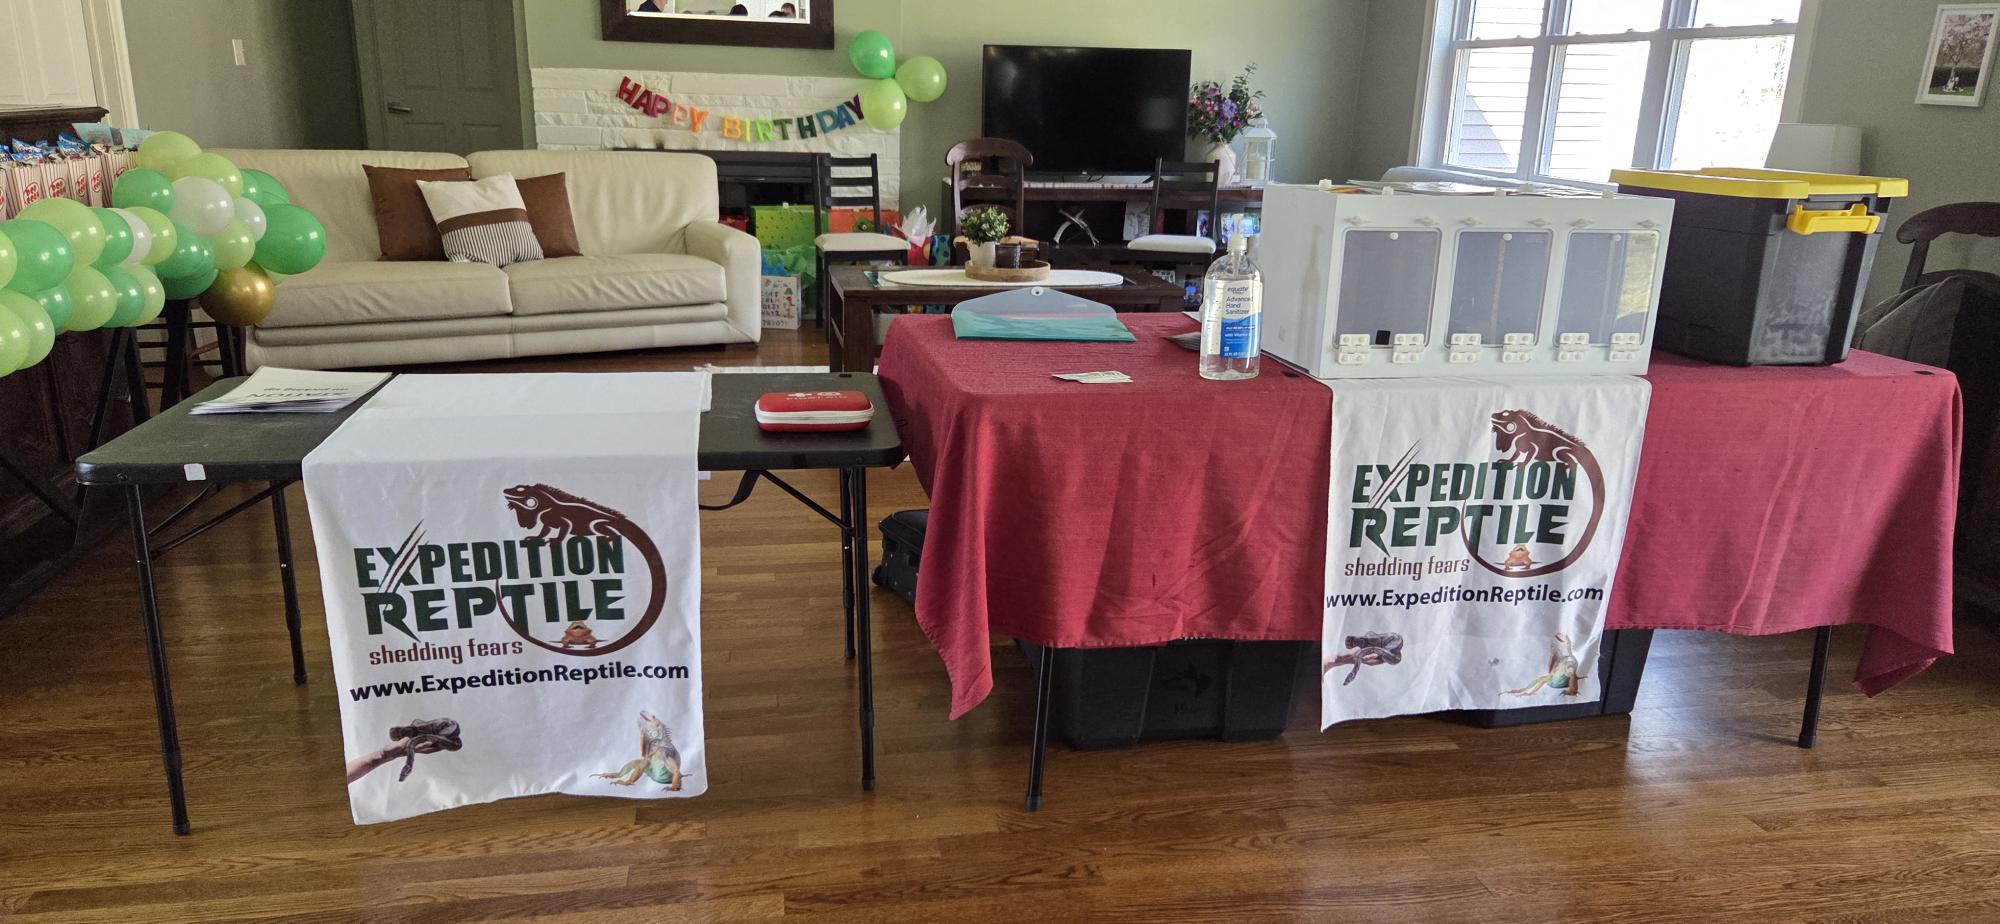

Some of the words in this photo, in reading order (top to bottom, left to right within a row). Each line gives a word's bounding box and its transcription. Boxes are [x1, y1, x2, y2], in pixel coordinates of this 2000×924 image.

[616, 76, 709, 133] HAPPY
[721, 94, 865, 144] BIRTHDAY
[1351, 459, 1578, 503] EXPEDITION
[1349, 503, 1569, 557] REPTILE
[353, 534, 625, 588] EXPEDITION
[1344, 555, 1422, 581] shedding
[1427, 556, 1470, 576] fears
[361, 578, 626, 643] REPTILE
[1326, 583, 1604, 609] www.ExpeditionReptile.com
[369, 641, 464, 665] shedding
[467, 638, 523, 659] fears
[349, 661, 690, 702] www.ExpeditionReptile.com
